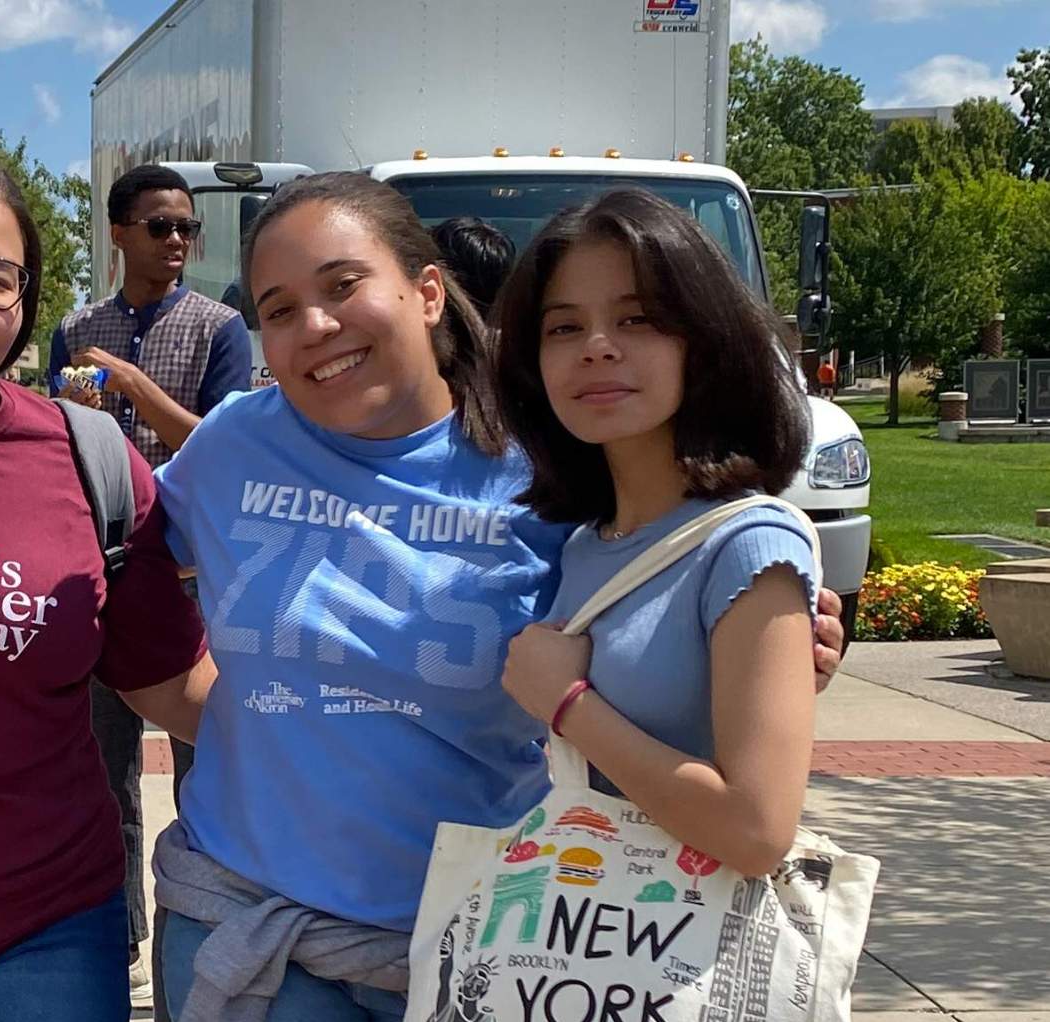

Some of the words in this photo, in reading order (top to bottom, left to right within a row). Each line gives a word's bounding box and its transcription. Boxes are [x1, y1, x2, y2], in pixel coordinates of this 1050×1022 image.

[241, 480, 398, 529] WELCOME
[408, 504, 510, 546] HOME
[268, 681, 293, 696] The
[323, 700, 351, 714] and
[393, 699, 423, 717] Life
[623, 843, 669, 859] Central
[626, 862, 656, 876] Park
[546, 893, 696, 963] NEW
[507, 954, 570, 972] BROOKLYN
[669, 955, 702, 977] Times
[662, 967, 704, 992] Square
[788, 949, 817, 1012] Broadway
